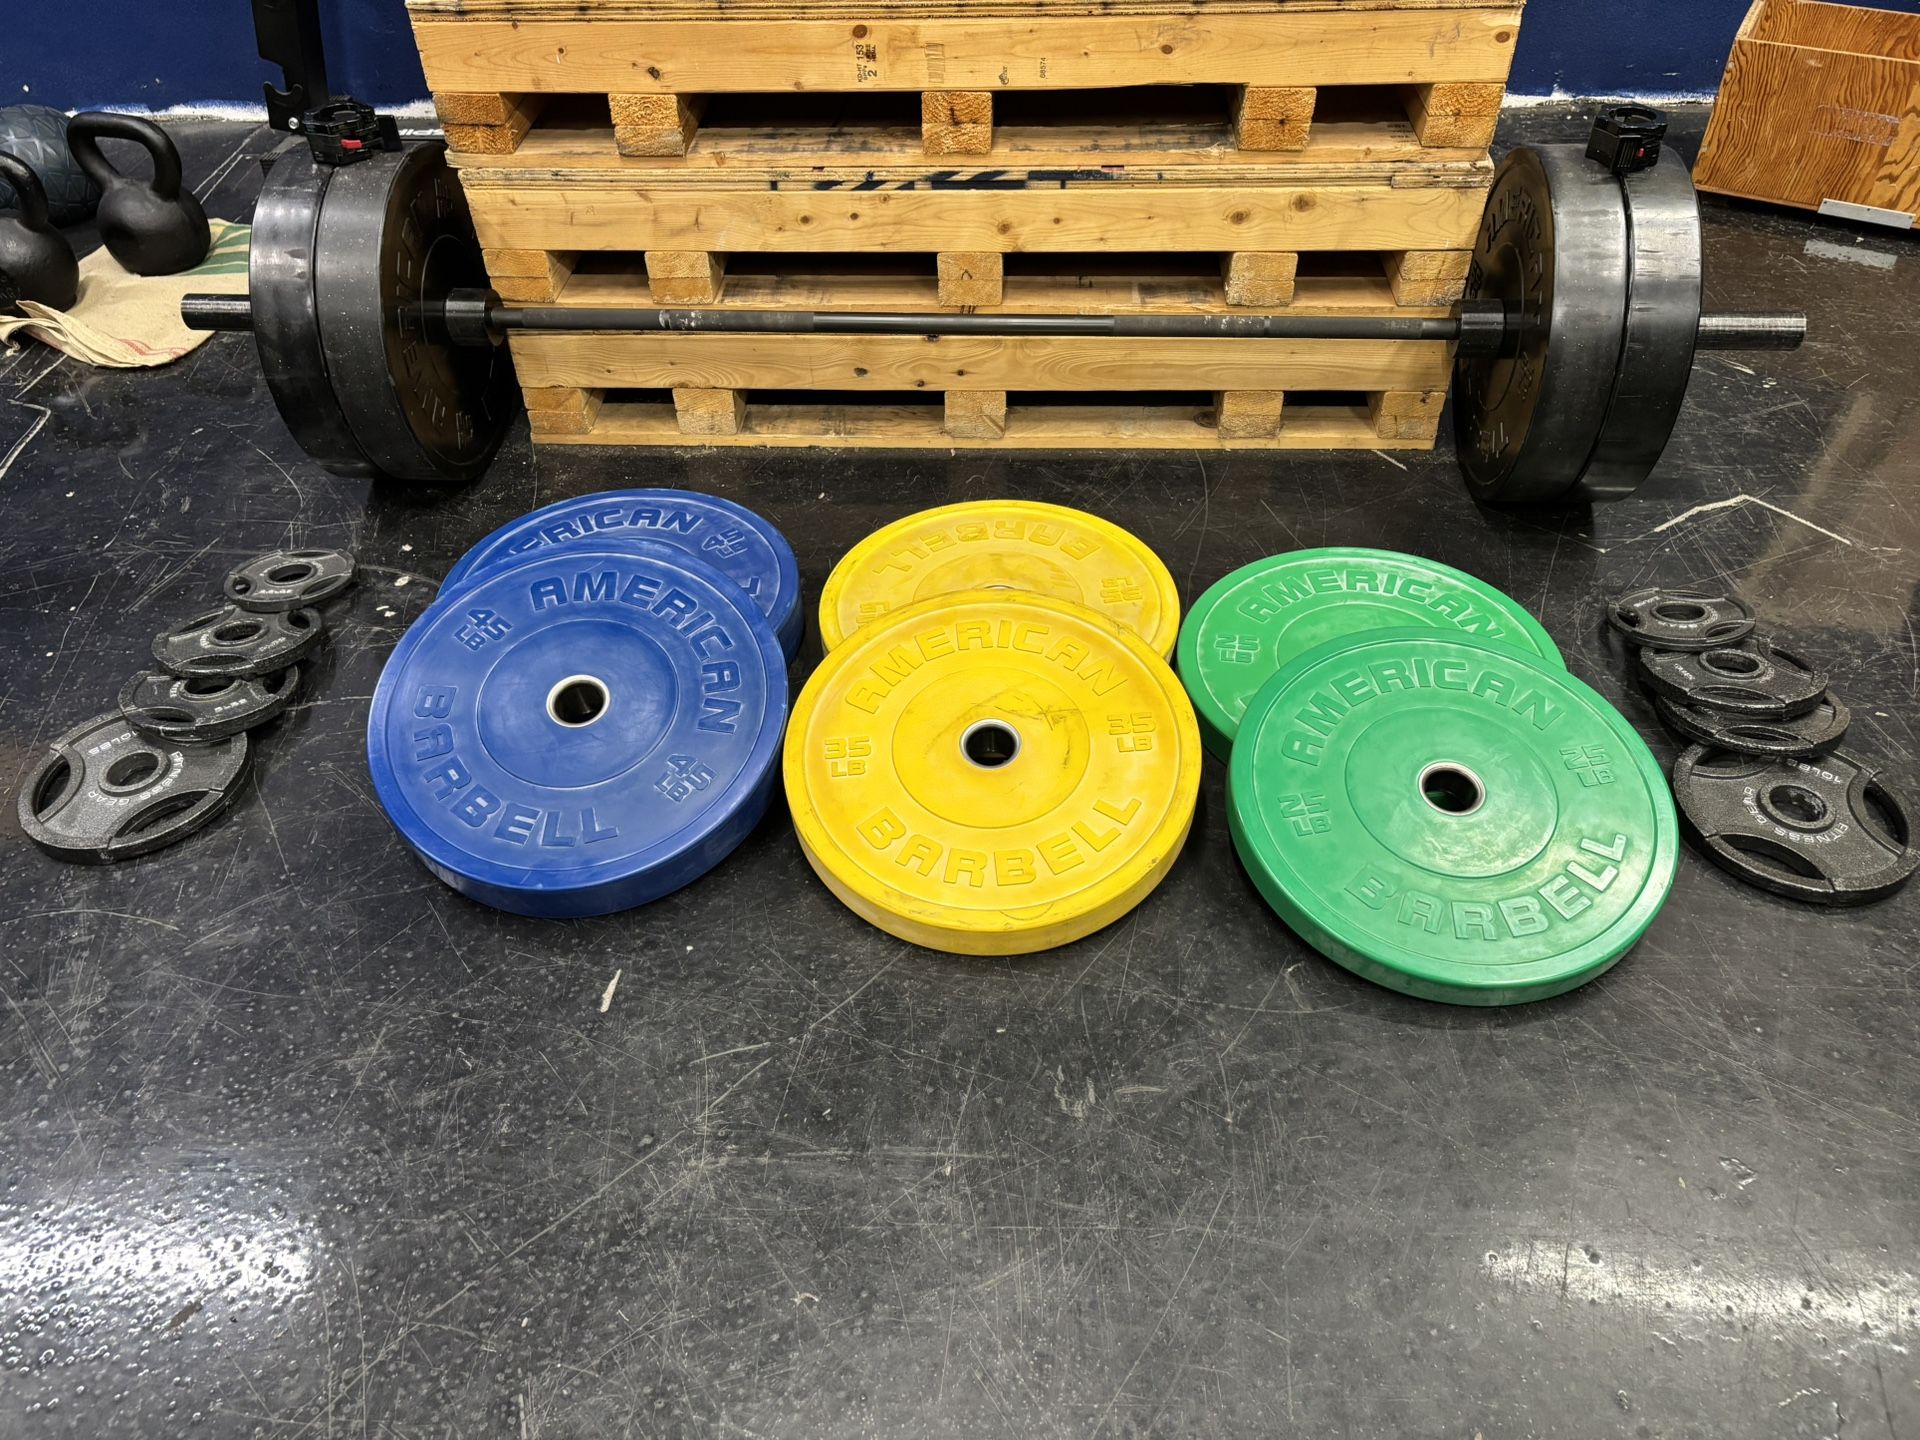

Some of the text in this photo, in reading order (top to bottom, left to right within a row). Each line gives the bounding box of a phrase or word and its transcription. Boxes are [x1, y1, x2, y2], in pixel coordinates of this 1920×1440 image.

[855, 44, 864, 61] 153
[510, 508, 703, 554] RICAN
[701, 527, 745, 551] 45
[872, 519, 1102, 575] BARBELL
[1099, 586, 1144, 604] 35
[1238, 568, 1507, 640] AMERICAN
[453, 623, 488, 653] LB
[466, 608, 513, 641] 45
[530, 571, 745, 736] AMERICAN
[1213, 632, 1260, 653] 25
[1219, 649, 1255, 665] LB
[845, 620, 1129, 715] AMERICAN
[1107, 711, 1156, 736] 35
[1281, 655, 1567, 768] AMERICAN
[824, 736, 872, 760] 35
[1116, 732, 1154, 753] LB
[1559, 744, 1614, 771] 25
[88, 751, 184, 806] FITNESS GEAR
[413, 684, 619, 848] BARBELL
[666, 753, 719, 791] 45
[831, 759, 866, 778] LB
[1577, 767, 1617, 788] LB
[654, 771, 692, 804] LB
[1277, 790, 1329, 819] 25
[1742, 786, 1849, 845] FITNESS GEAR
[1293, 814, 1332, 837] LB
[856, 797, 1143, 888] BARBELL
[1344, 831, 1628, 942] BARBELL
